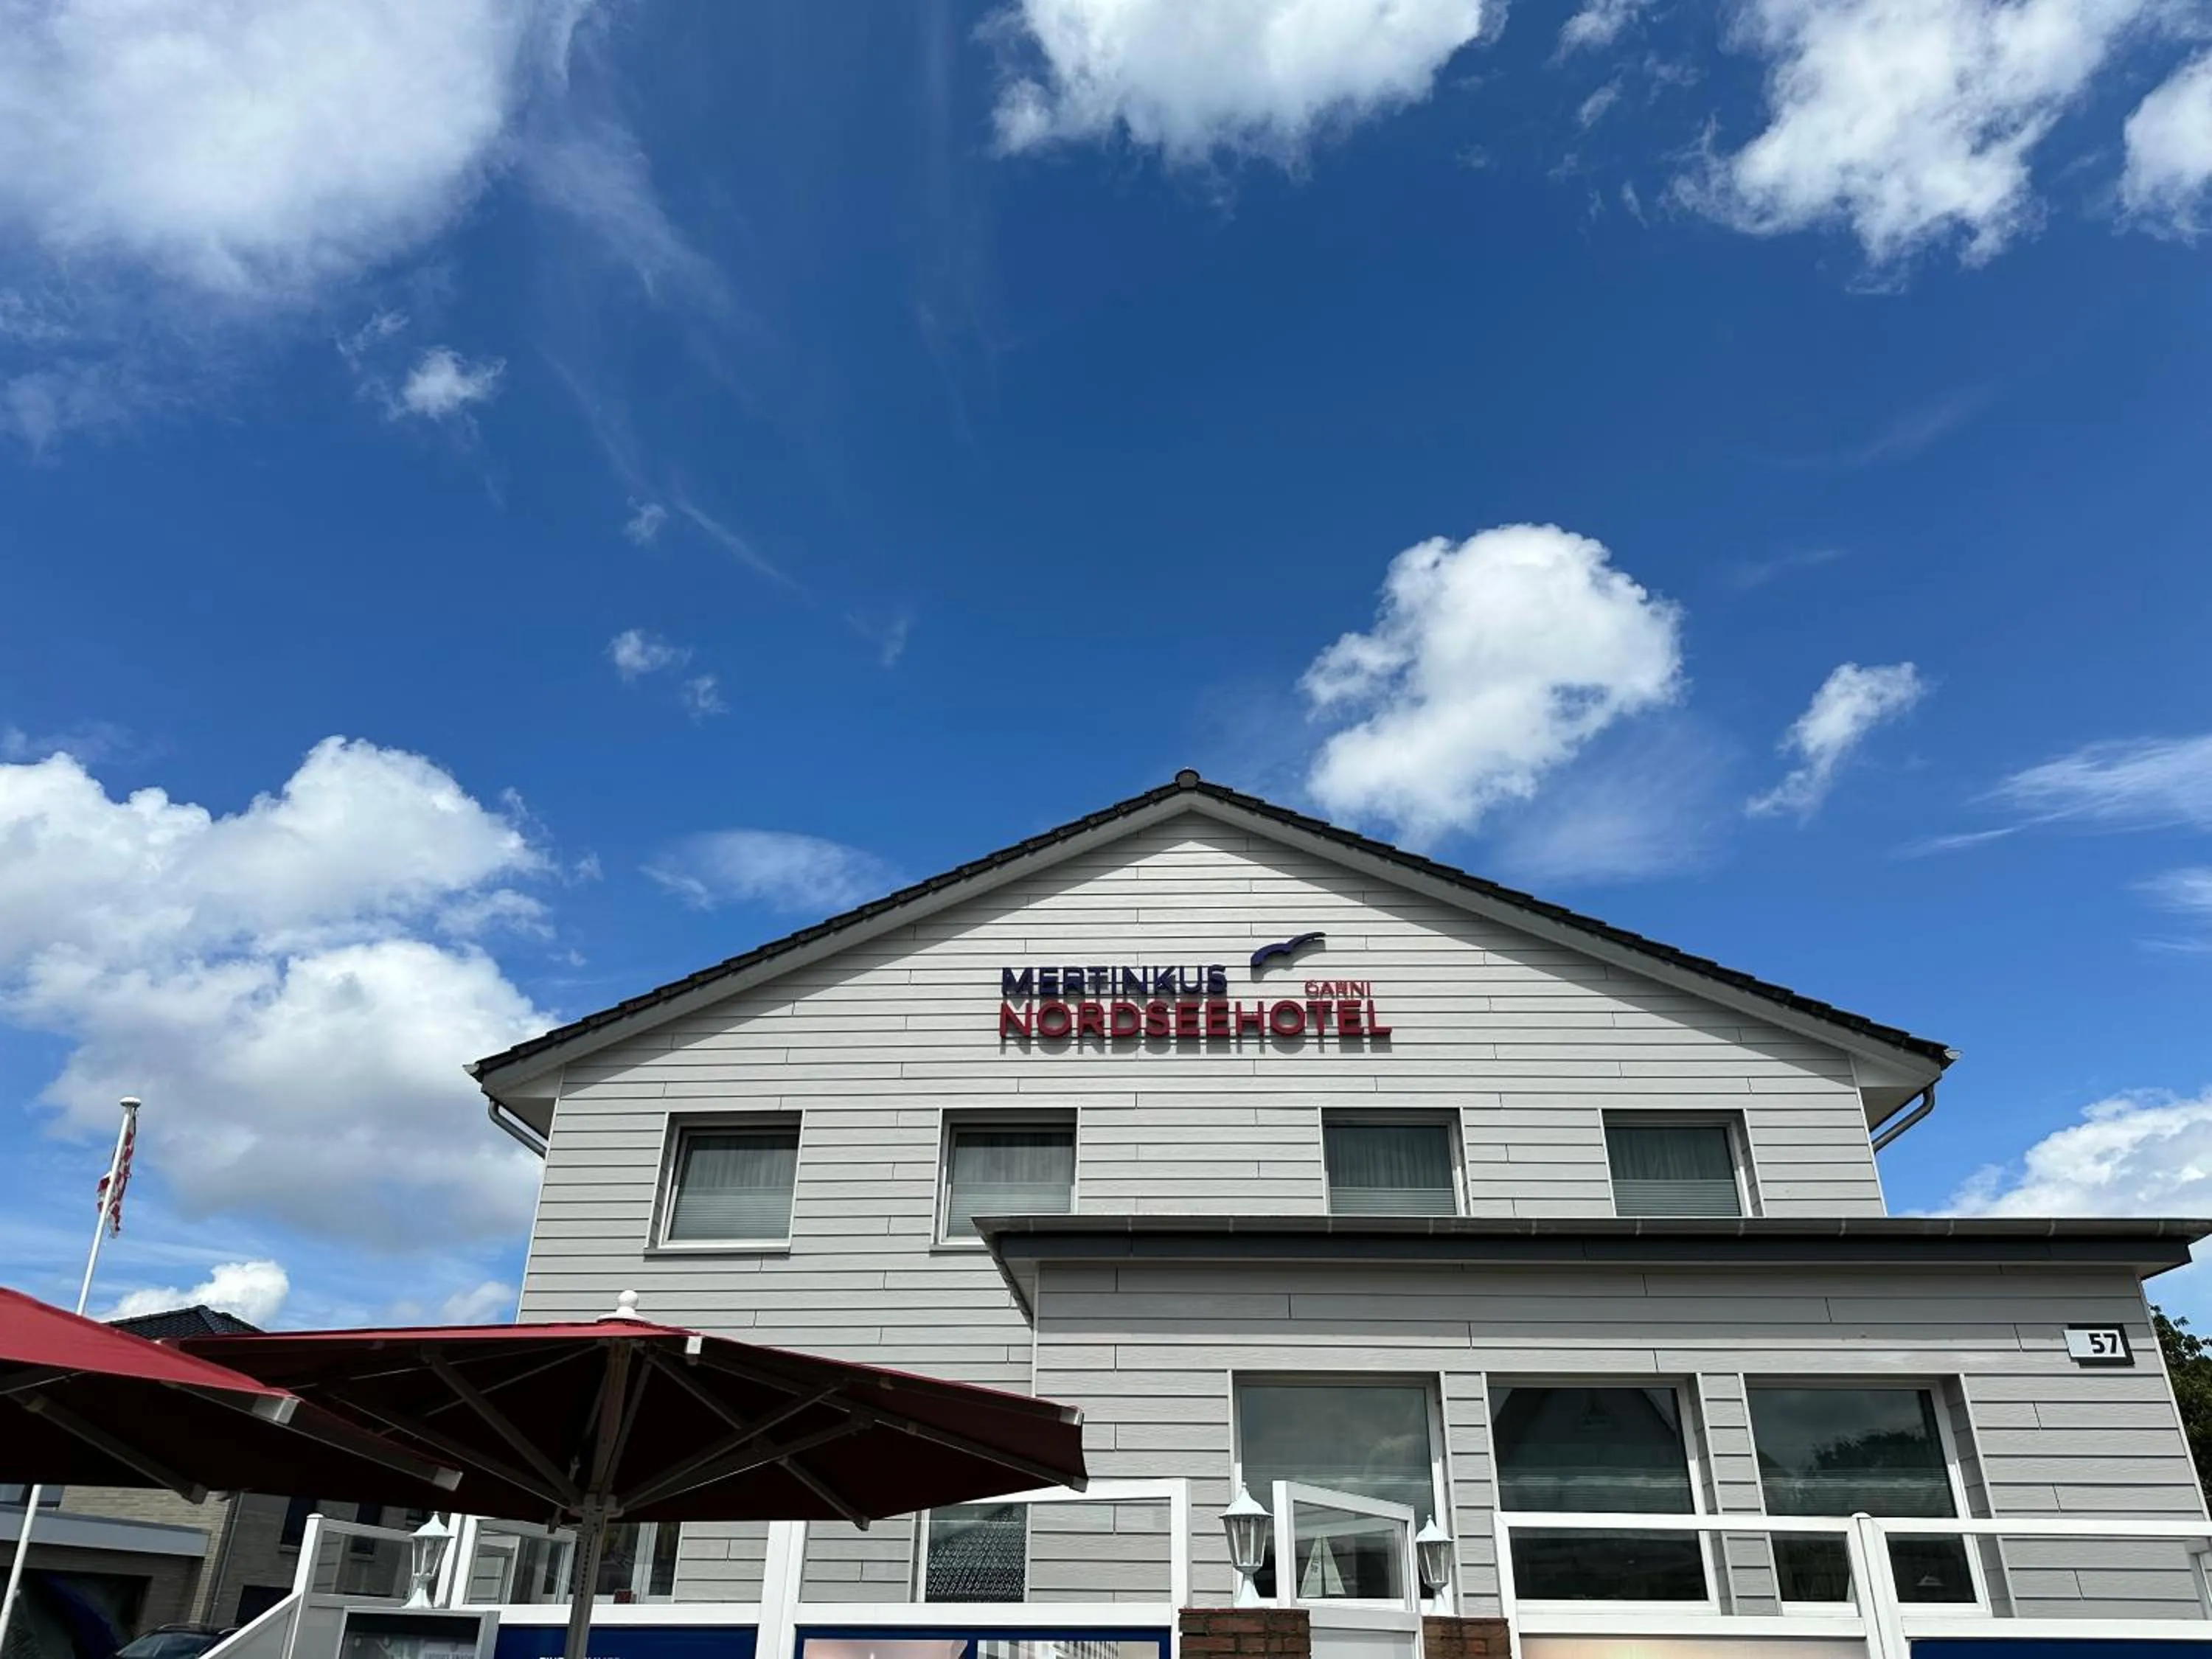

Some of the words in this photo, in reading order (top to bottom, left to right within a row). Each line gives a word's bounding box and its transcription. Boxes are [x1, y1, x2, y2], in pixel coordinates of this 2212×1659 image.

[1002, 964, 1228, 995] MERTINKUS
[999, 998, 1392, 1038] NORDSEEHOTEL
[2088, 1333, 2117, 1354] 57
